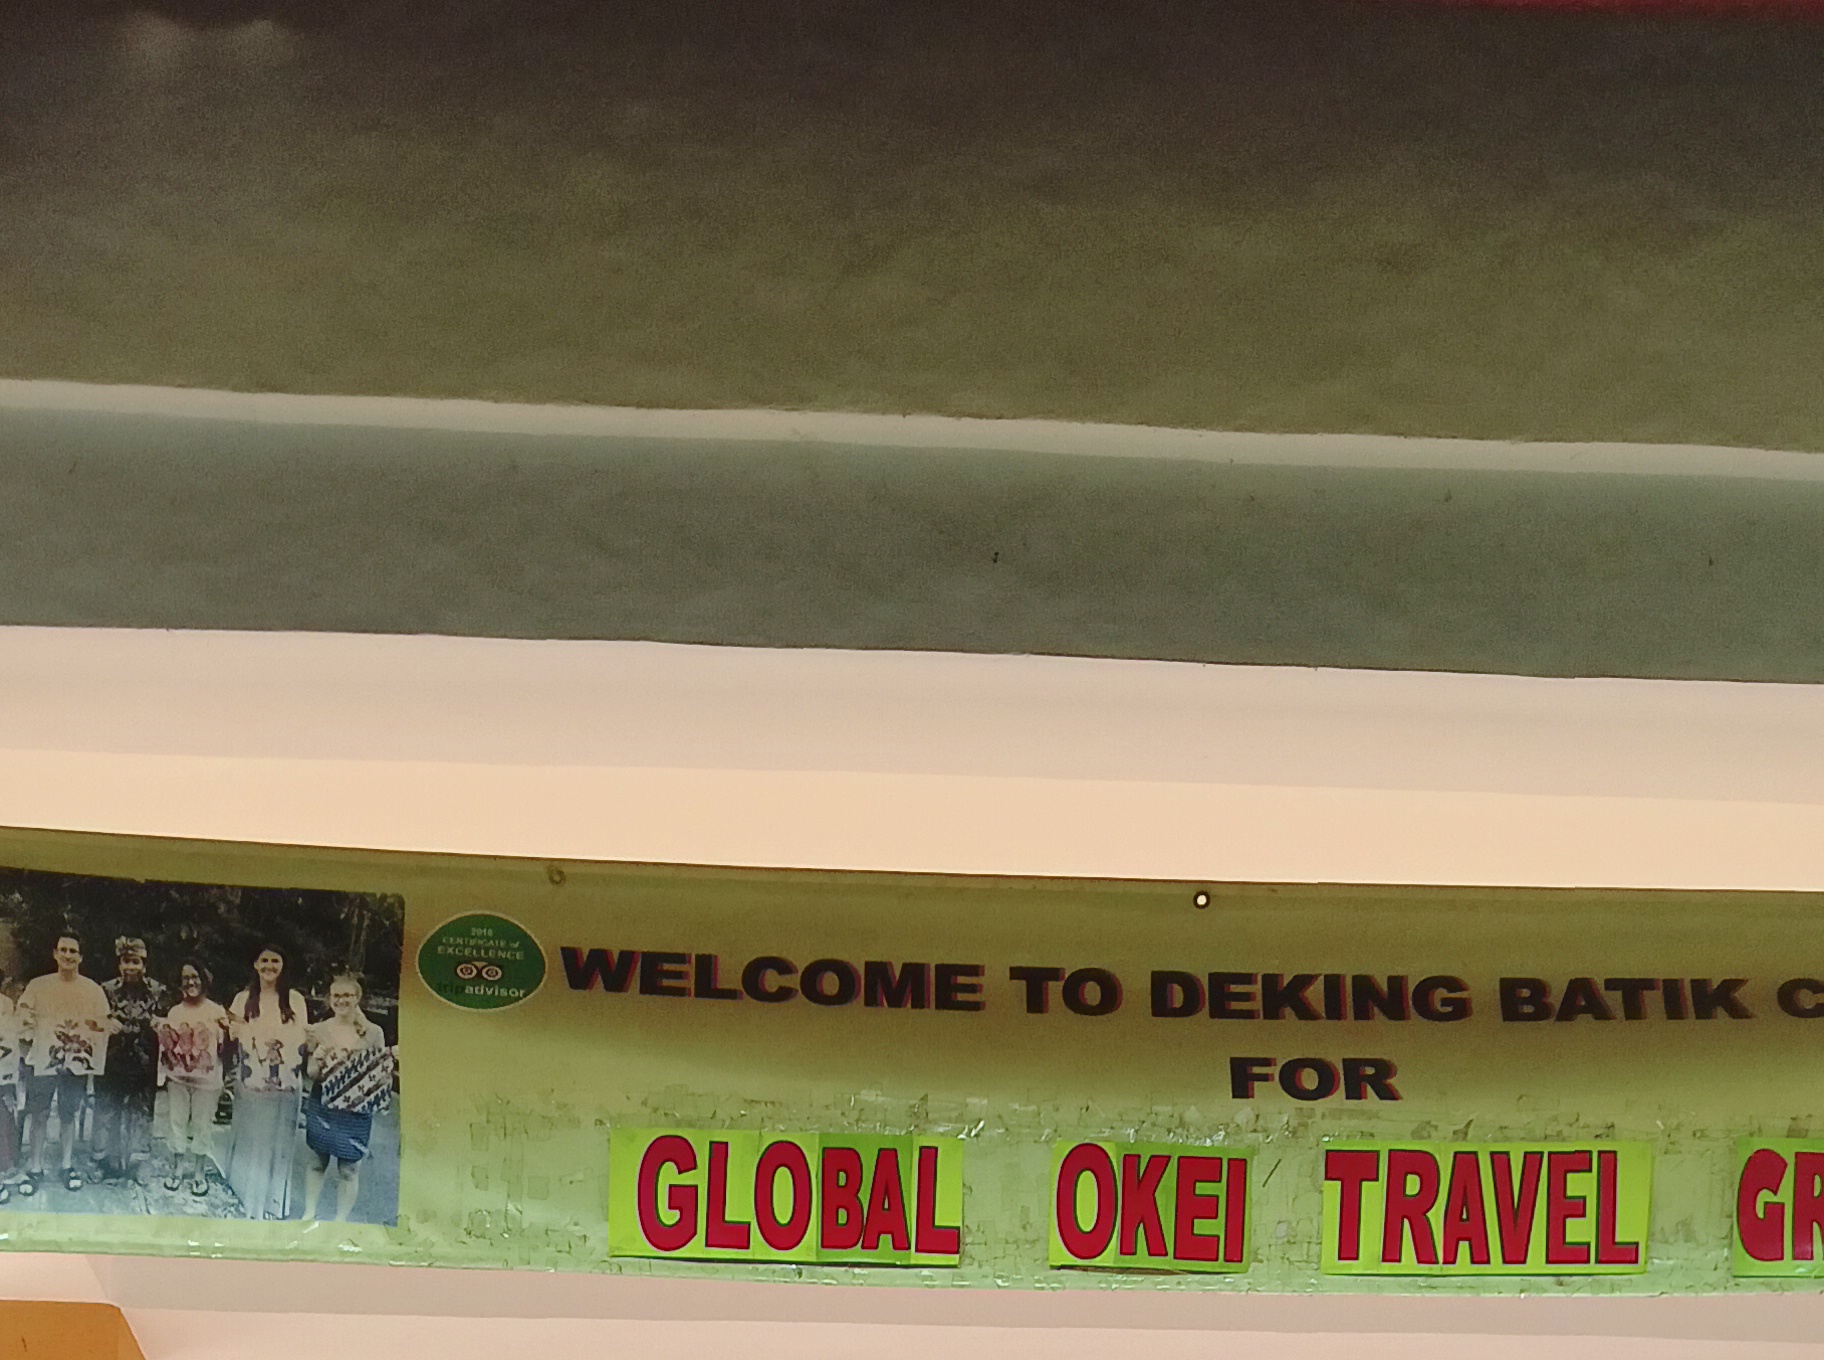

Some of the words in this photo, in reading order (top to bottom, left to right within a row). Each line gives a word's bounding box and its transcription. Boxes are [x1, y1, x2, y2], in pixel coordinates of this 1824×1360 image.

[437, 945, 525, 960] EXCELLENCE
[559, 946, 986, 1012] WELCOME
[1009, 965, 1123, 1018] TO
[1150, 970, 1474, 1022] DEKING
[1499, 976, 1758, 1023] BATIK
[1229, 1055, 1403, 1101] FOR
[635, 1134, 961, 1256] GLOBAL
[1055, 1142, 1248, 1264] OKEI
[1323, 1148, 1640, 1266] TRAVEL
